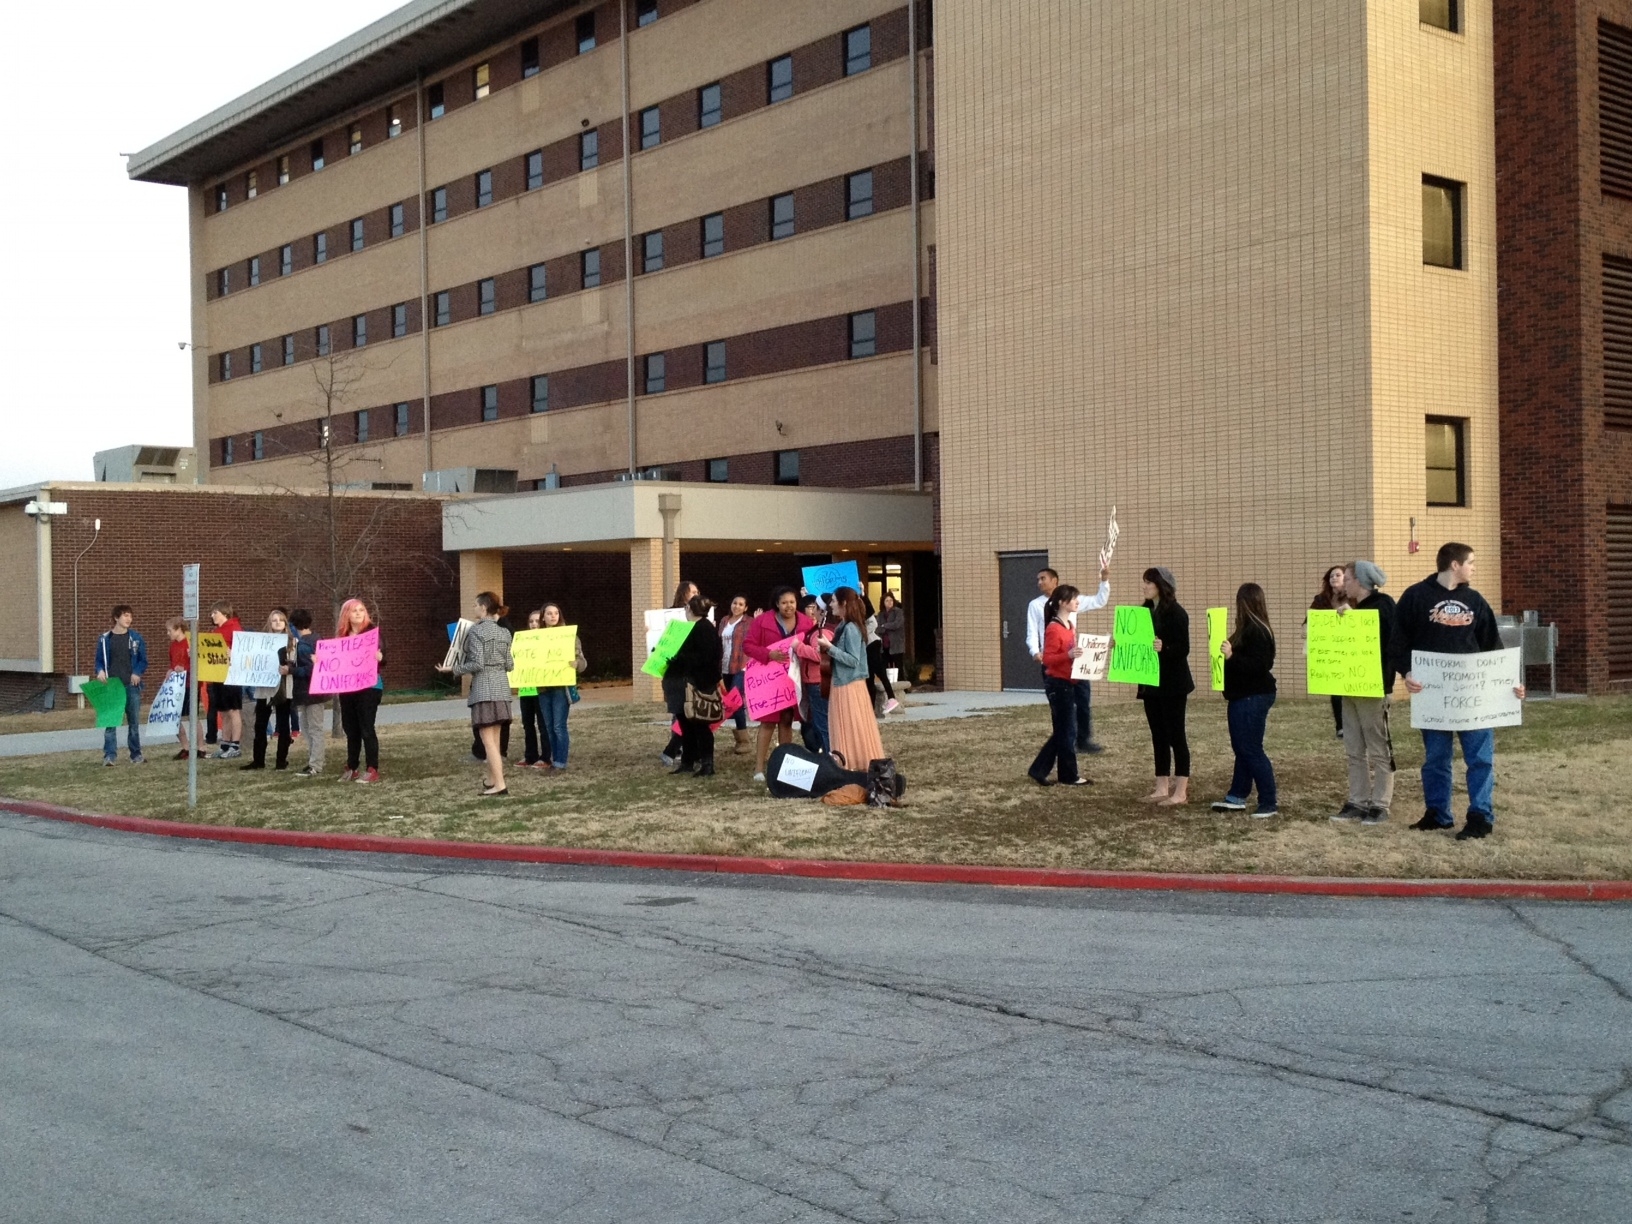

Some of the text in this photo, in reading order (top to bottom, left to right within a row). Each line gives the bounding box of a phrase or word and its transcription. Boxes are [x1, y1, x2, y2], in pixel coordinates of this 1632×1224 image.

[1115, 609, 1138, 636] NO
[236, 634, 254, 652] YOU
[512, 648, 562, 659] VOTE NO
[1112, 643, 1159, 674] UNIFORMS
[240, 654, 271, 671] UNIQUE
[318, 657, 341, 673] NO
[1349, 665, 1366, 678] NO
[1442, 671, 1488, 681] PROMOTE
[1444, 696, 1482, 709] FORCE
